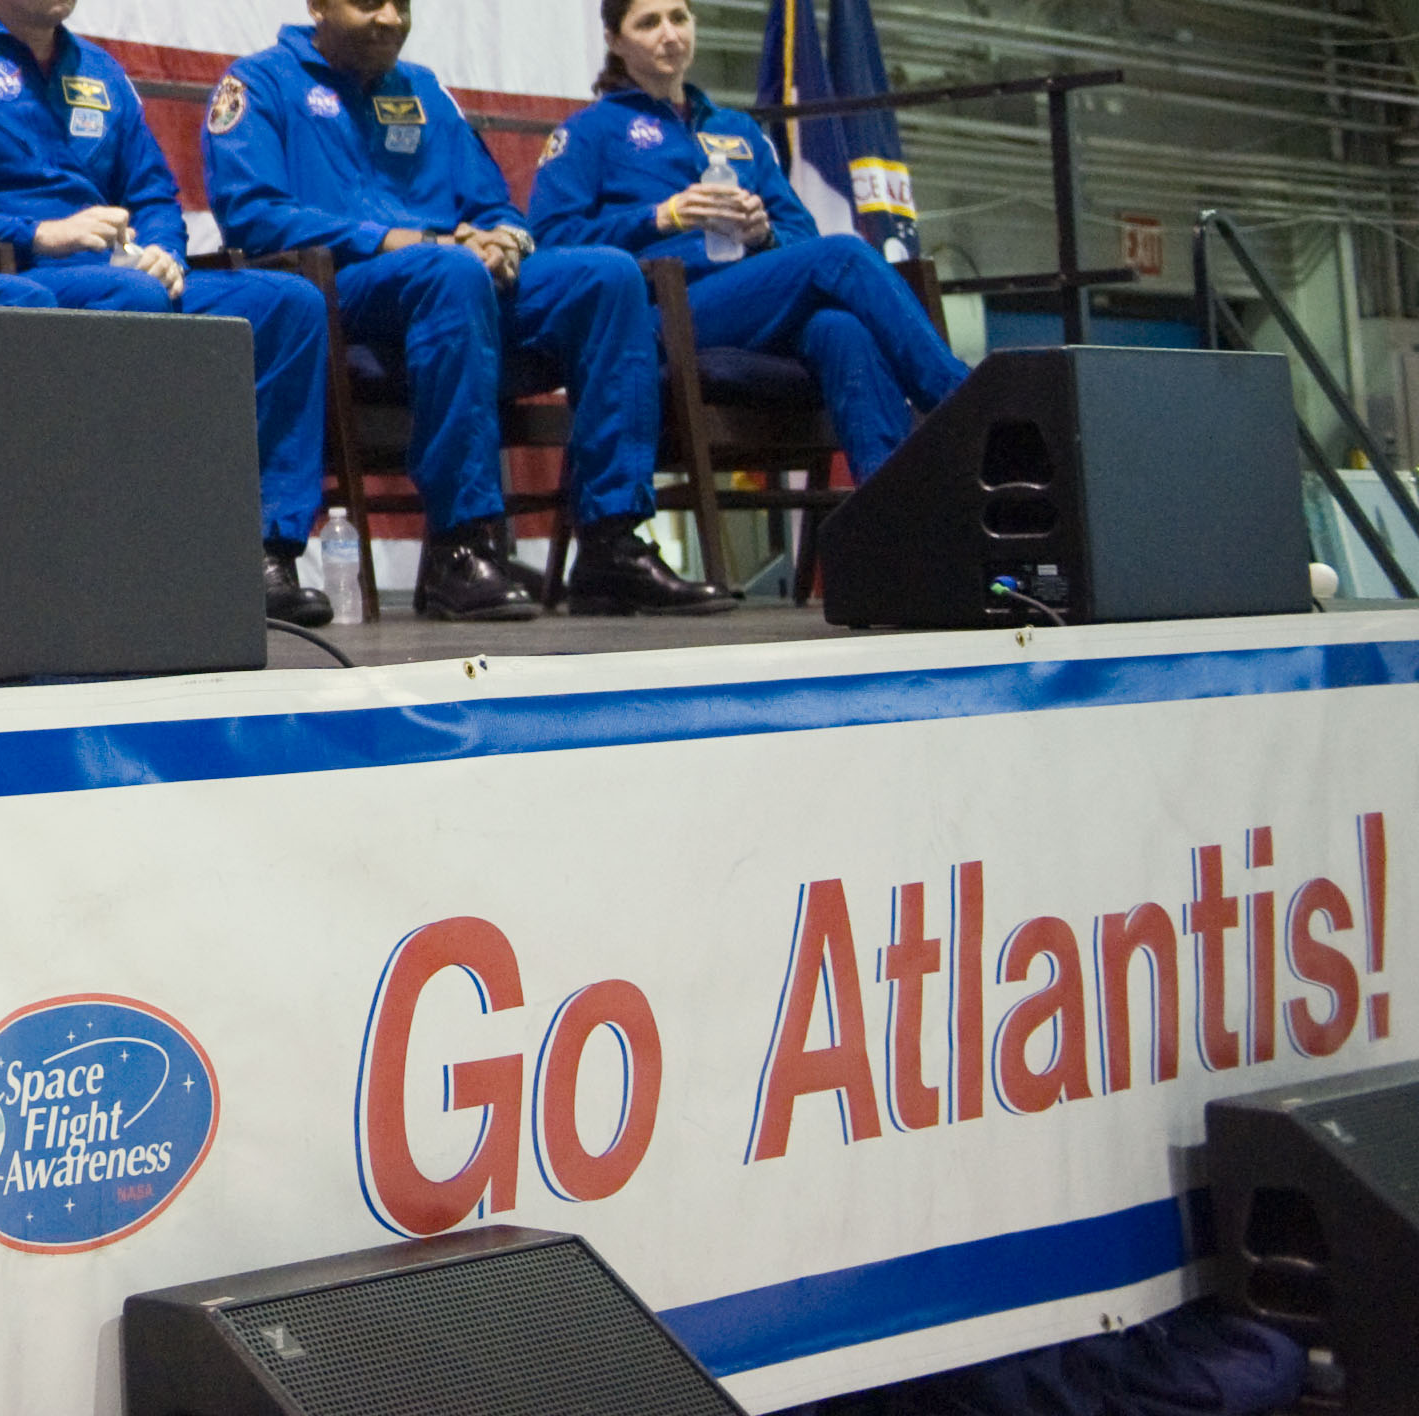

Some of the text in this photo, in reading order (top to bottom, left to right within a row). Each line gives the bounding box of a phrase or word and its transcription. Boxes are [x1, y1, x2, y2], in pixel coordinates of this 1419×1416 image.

[354, 811, 1389, 1240] Go Atlantis!
[5, 1060, 104, 1117] Space
[24, 1100, 123, 1160] Flight
[3, 1140, 172, 1196] Awareness
[117, 1183, 153, 1202] NASA
